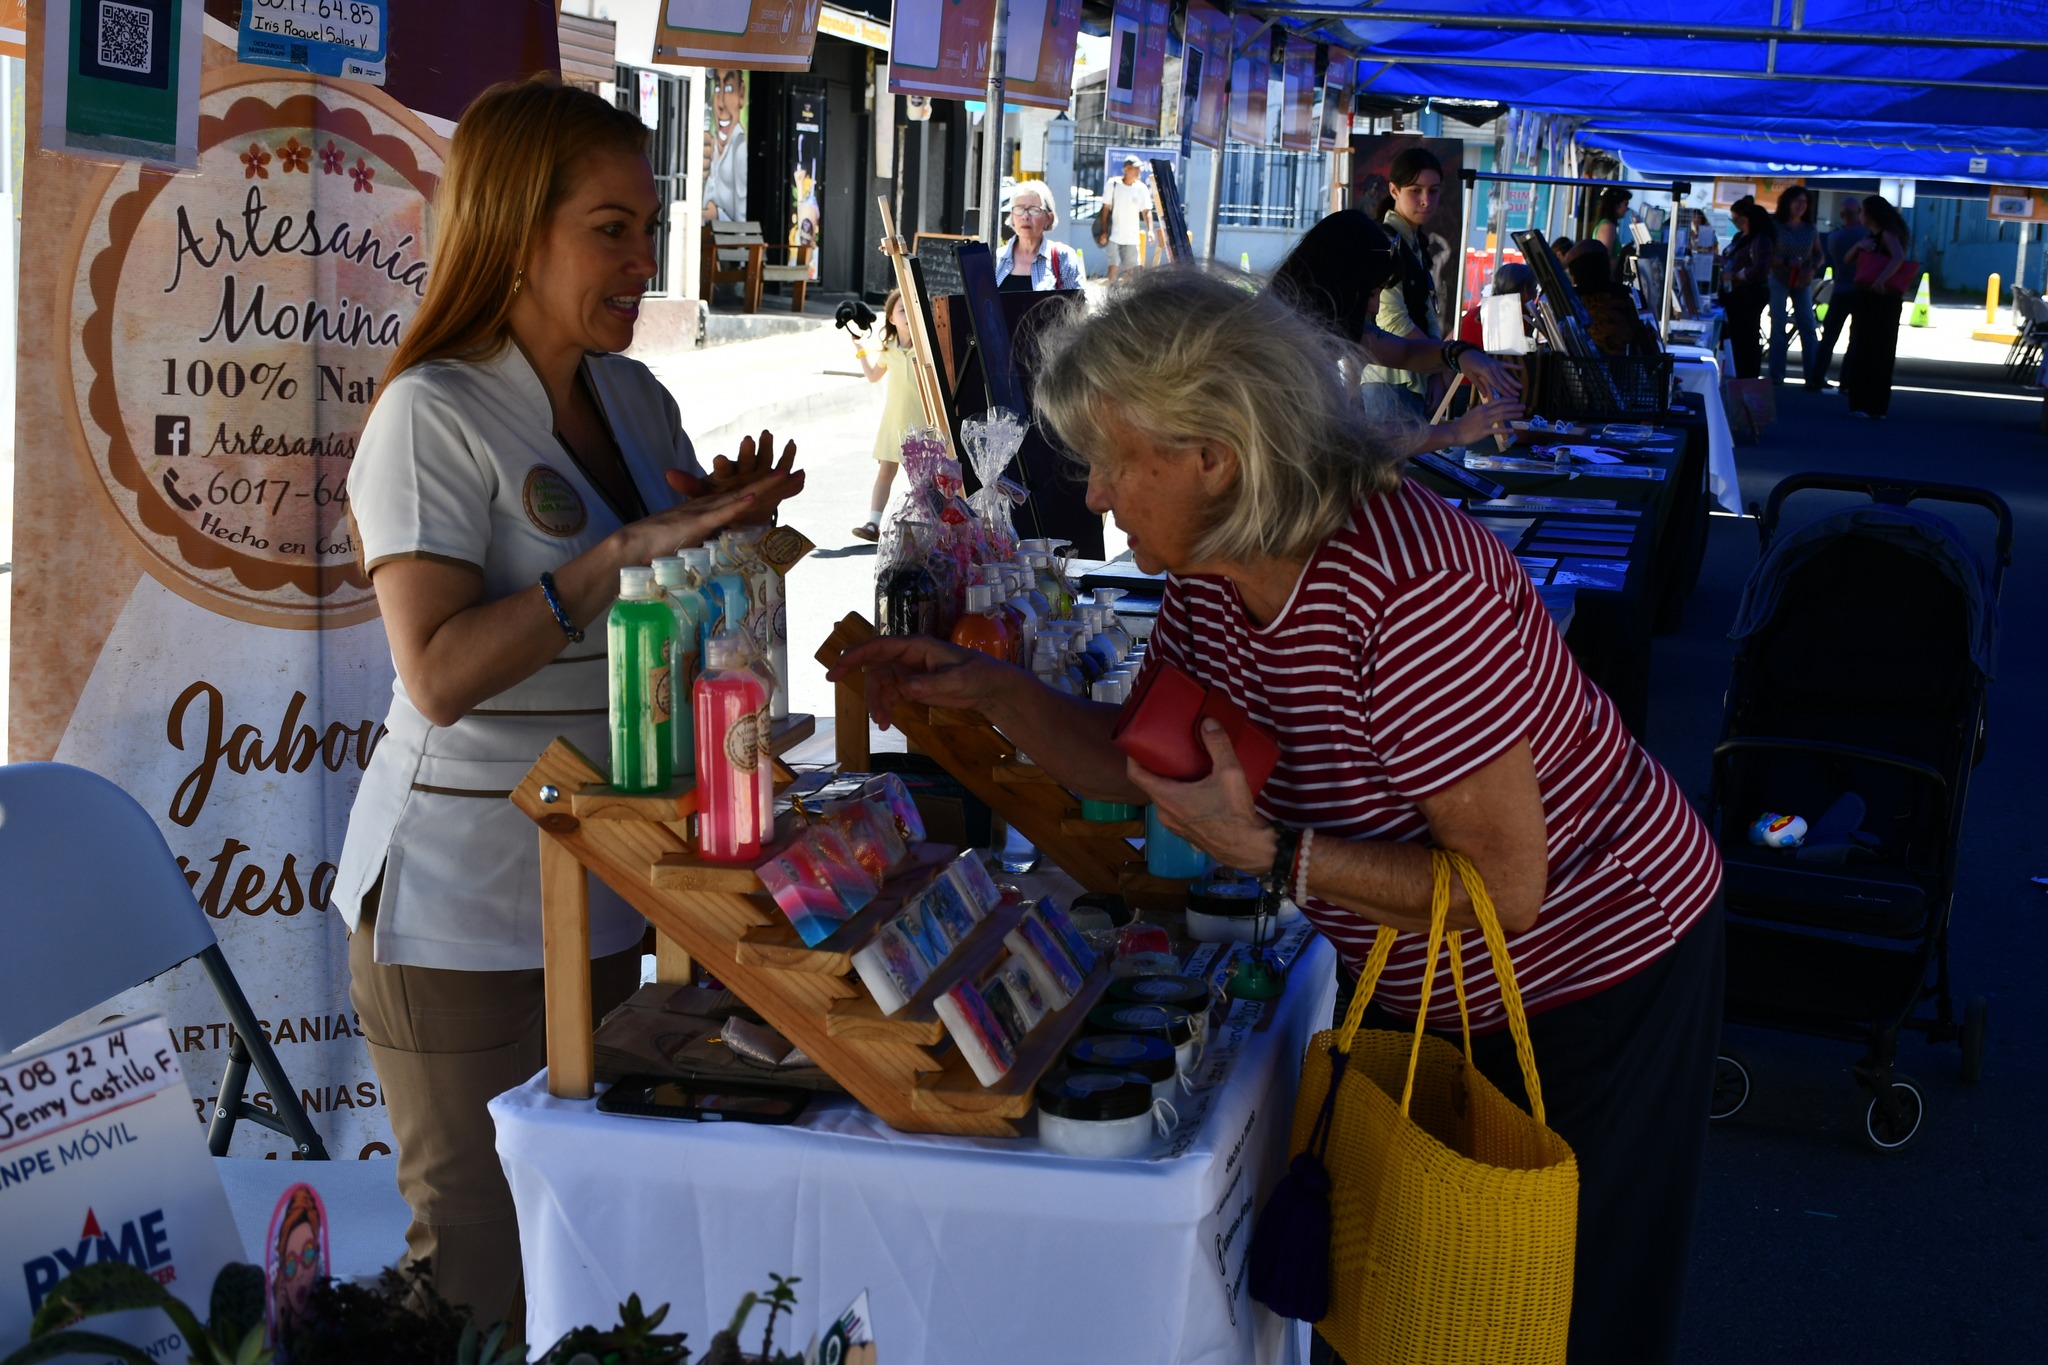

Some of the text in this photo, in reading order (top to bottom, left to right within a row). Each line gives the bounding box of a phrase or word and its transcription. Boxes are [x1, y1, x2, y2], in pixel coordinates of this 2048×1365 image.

[254, 15, 280, 33] Iris
[284, 19, 323, 41] Raquel
[325, 26, 356, 47] Salas
[199, 275, 400, 346] Monina
[161, 358, 377, 404] 100% Nat
[207, 470, 347, 516] 6017-64
[201, 511, 357, 555] Hecho en Cost
[19, 1060, 56, 1091] 08
[66, 1046, 96, 1075] 22
[70, 1059, 156, 1105] Castillo
[58, 1122, 138, 1166] MÓVIL
